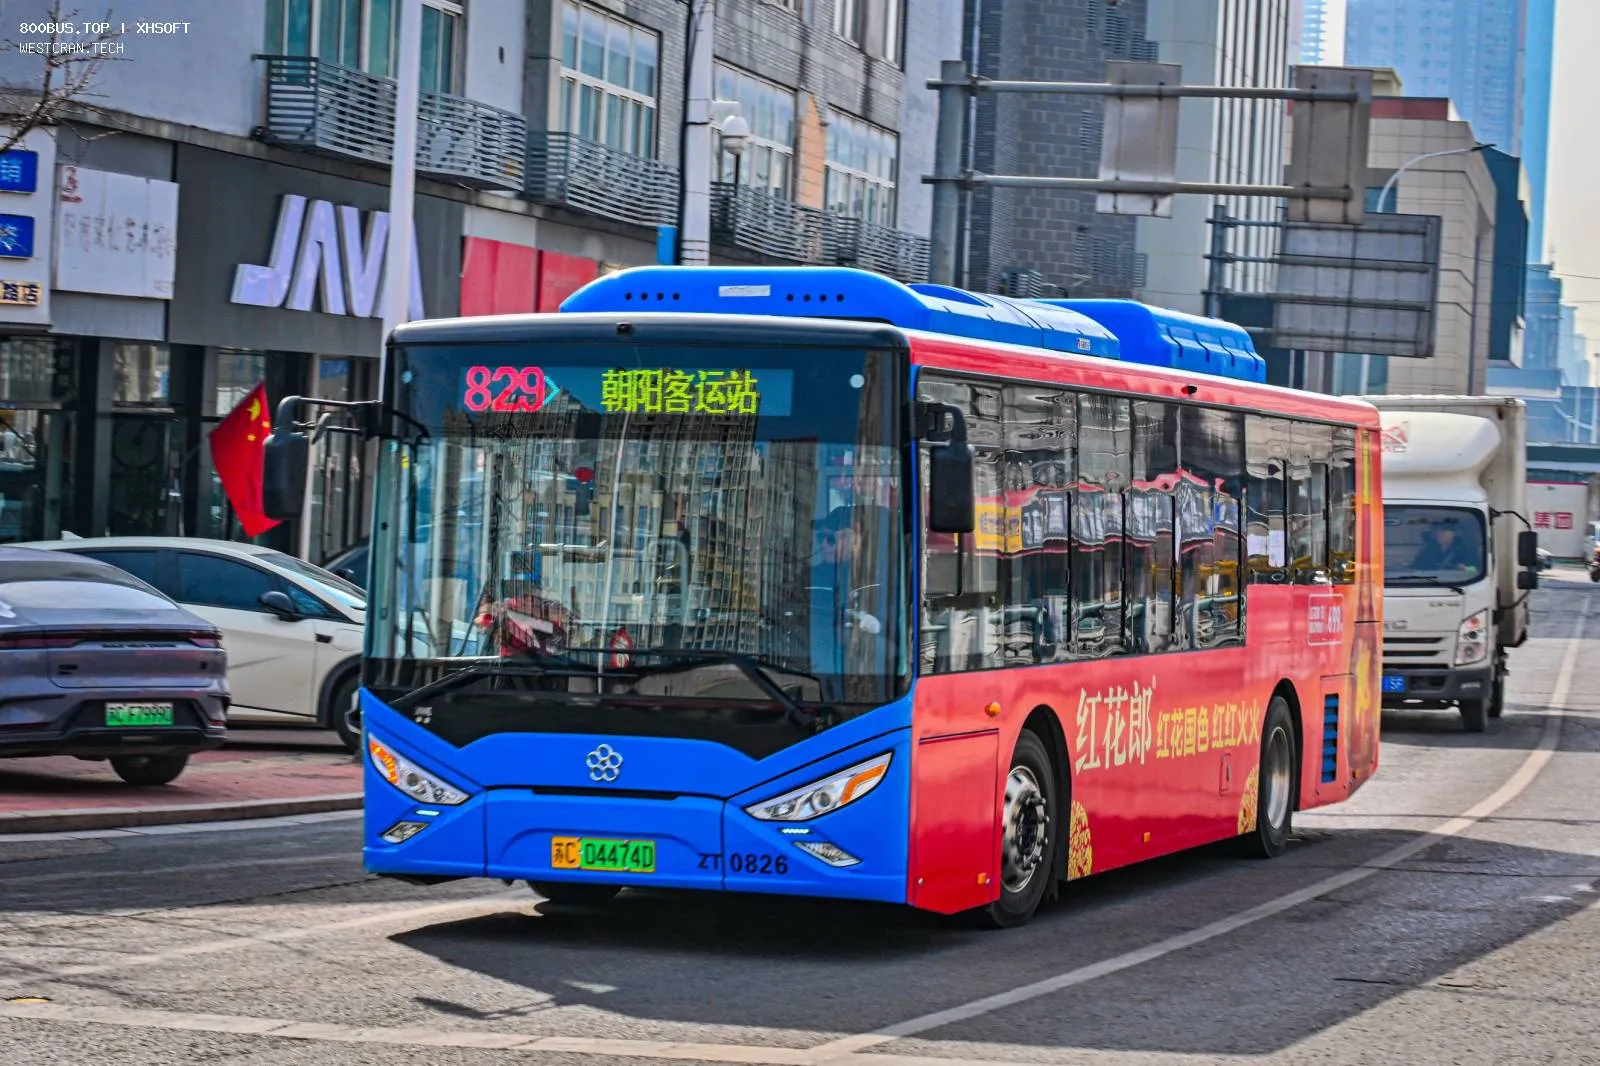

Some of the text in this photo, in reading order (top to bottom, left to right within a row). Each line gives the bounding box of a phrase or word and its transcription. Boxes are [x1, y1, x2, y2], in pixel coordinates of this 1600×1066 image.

[464, 366, 546, 413] 829
[601, 369, 759, 414] 朝阳客运站
[1075, 679, 1153, 776] 红花郎
[1156, 698, 1260, 760] 红花国色 红红火火
[584, 843, 654, 868] 04474D
[698, 852, 789, 875] ZT 0826
